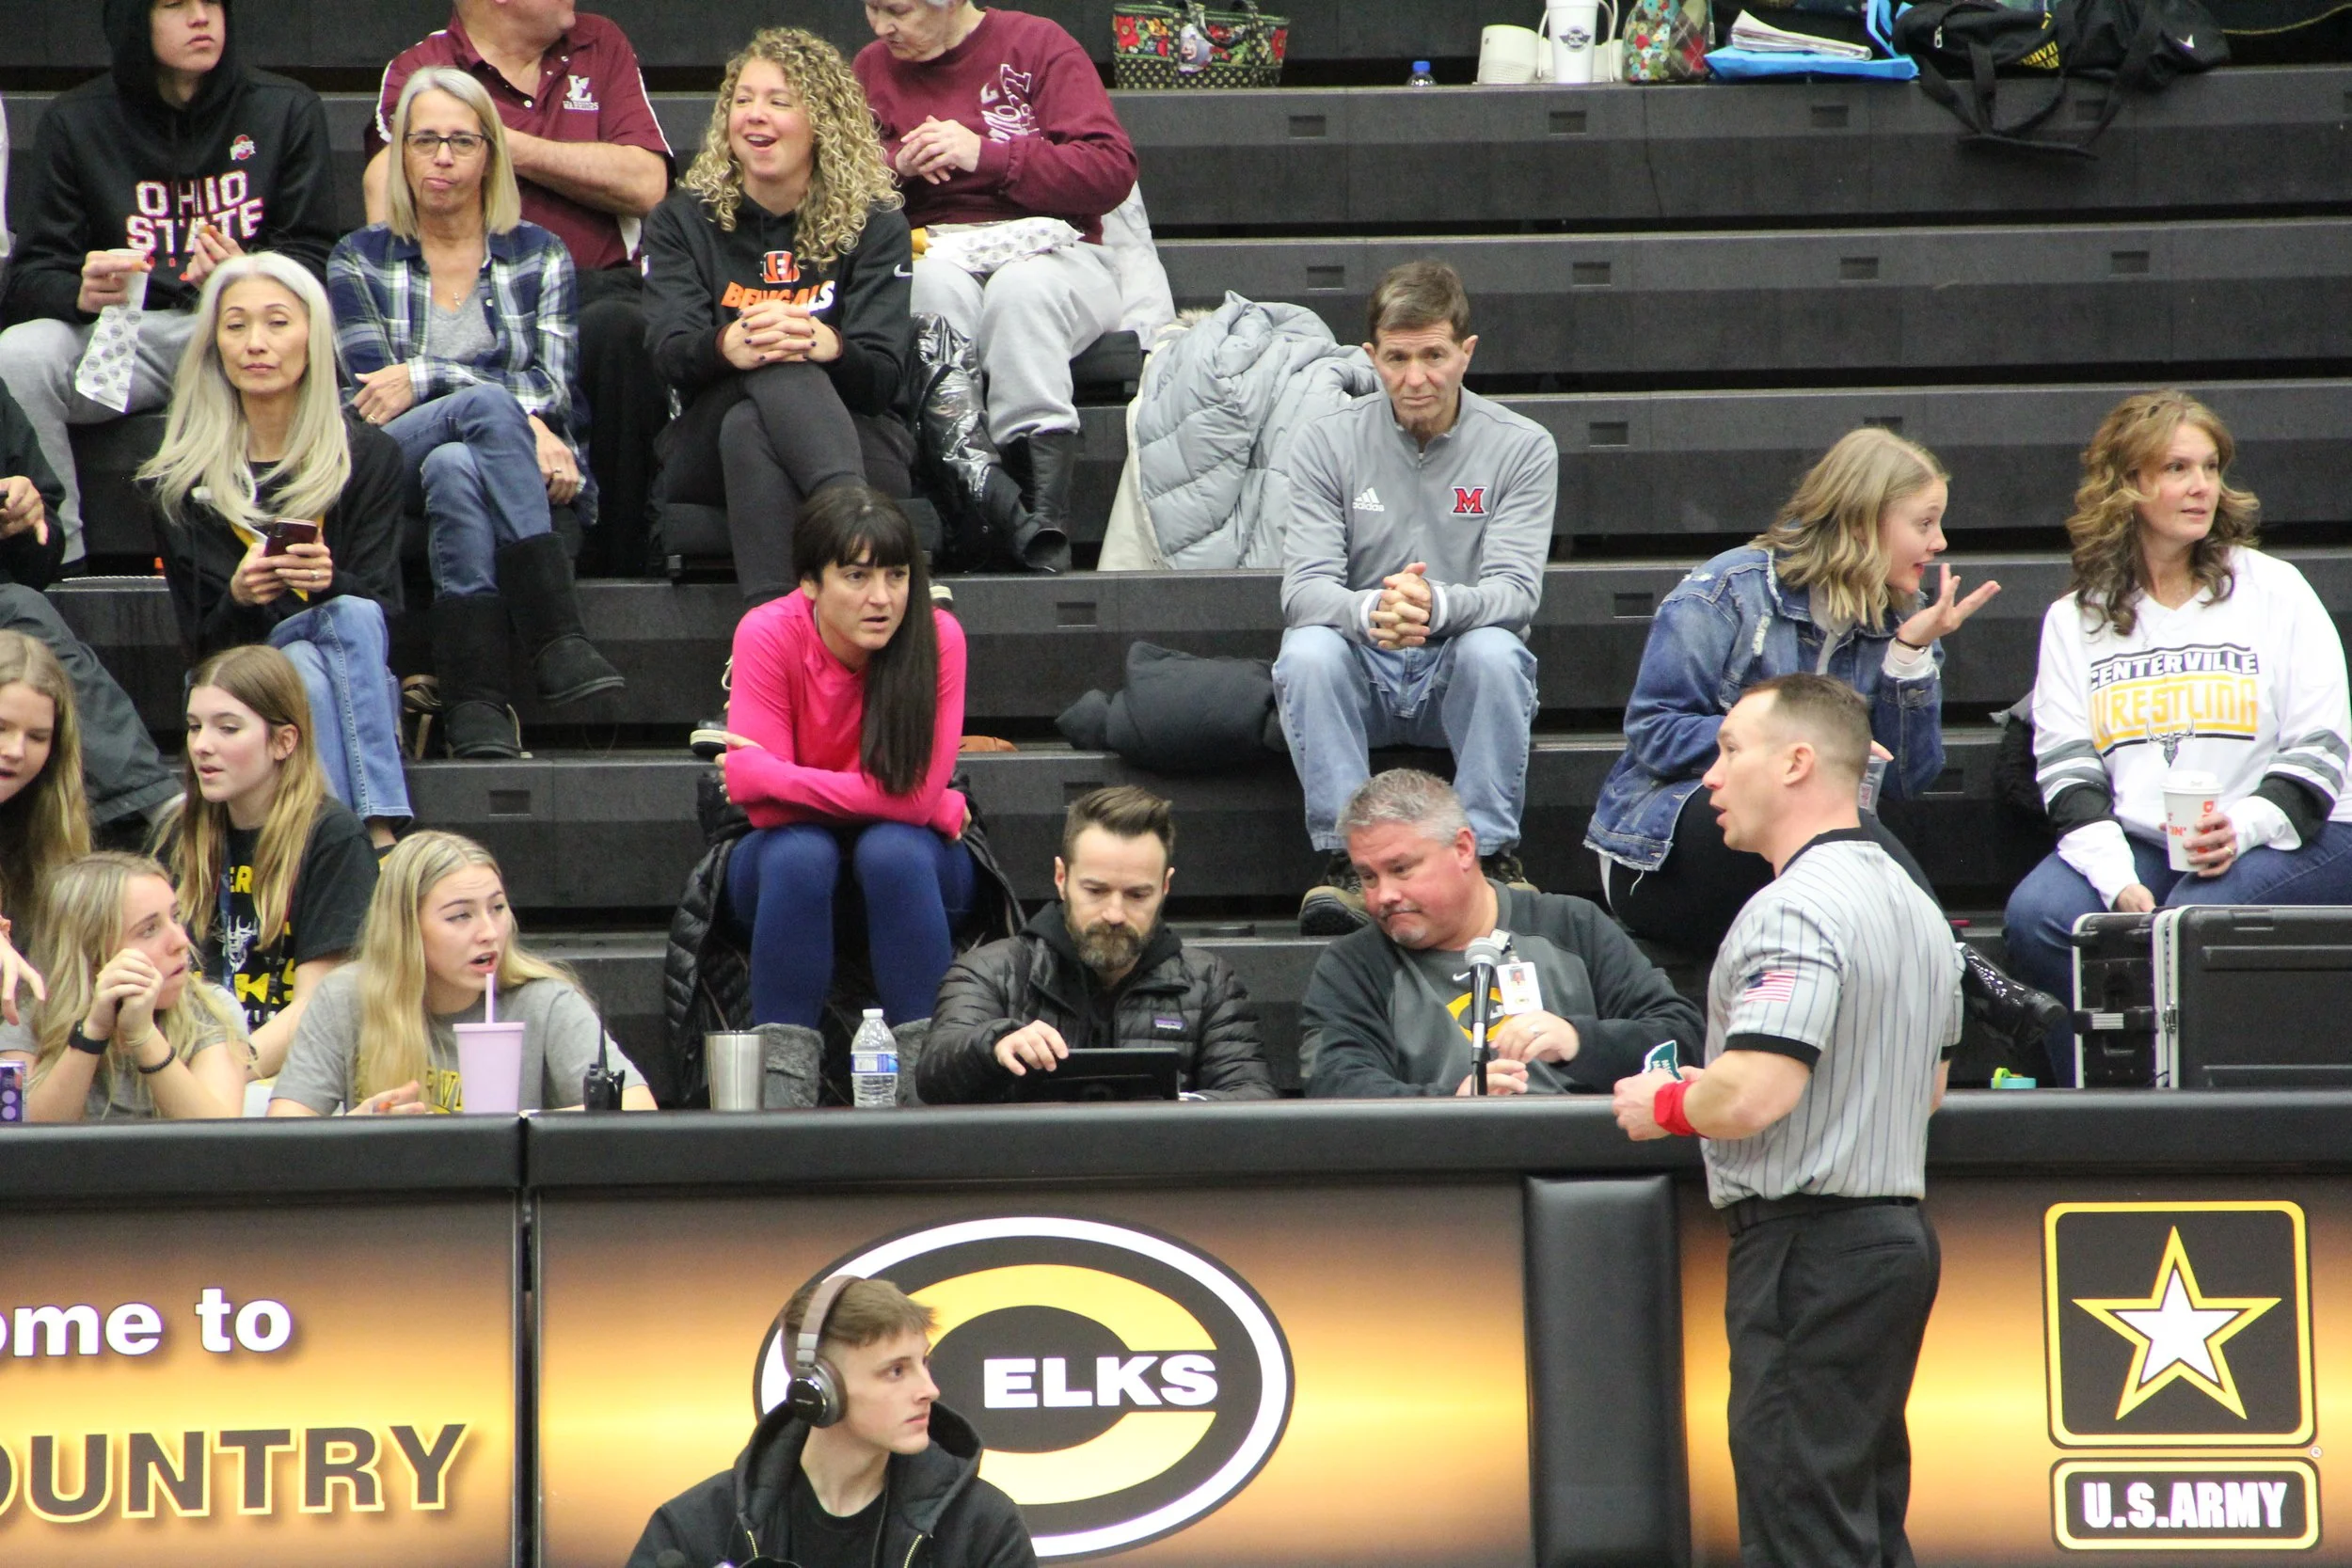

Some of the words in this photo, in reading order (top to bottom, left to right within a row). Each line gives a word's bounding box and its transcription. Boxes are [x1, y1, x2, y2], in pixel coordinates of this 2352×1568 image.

[1451, 486, 1489, 515] M
[0, 1302, 163, 1357] me
[195, 1287, 293, 1353] to
[984, 1354, 1218, 1408] ELKS
[0, 1418, 470, 1523] UNTRY
